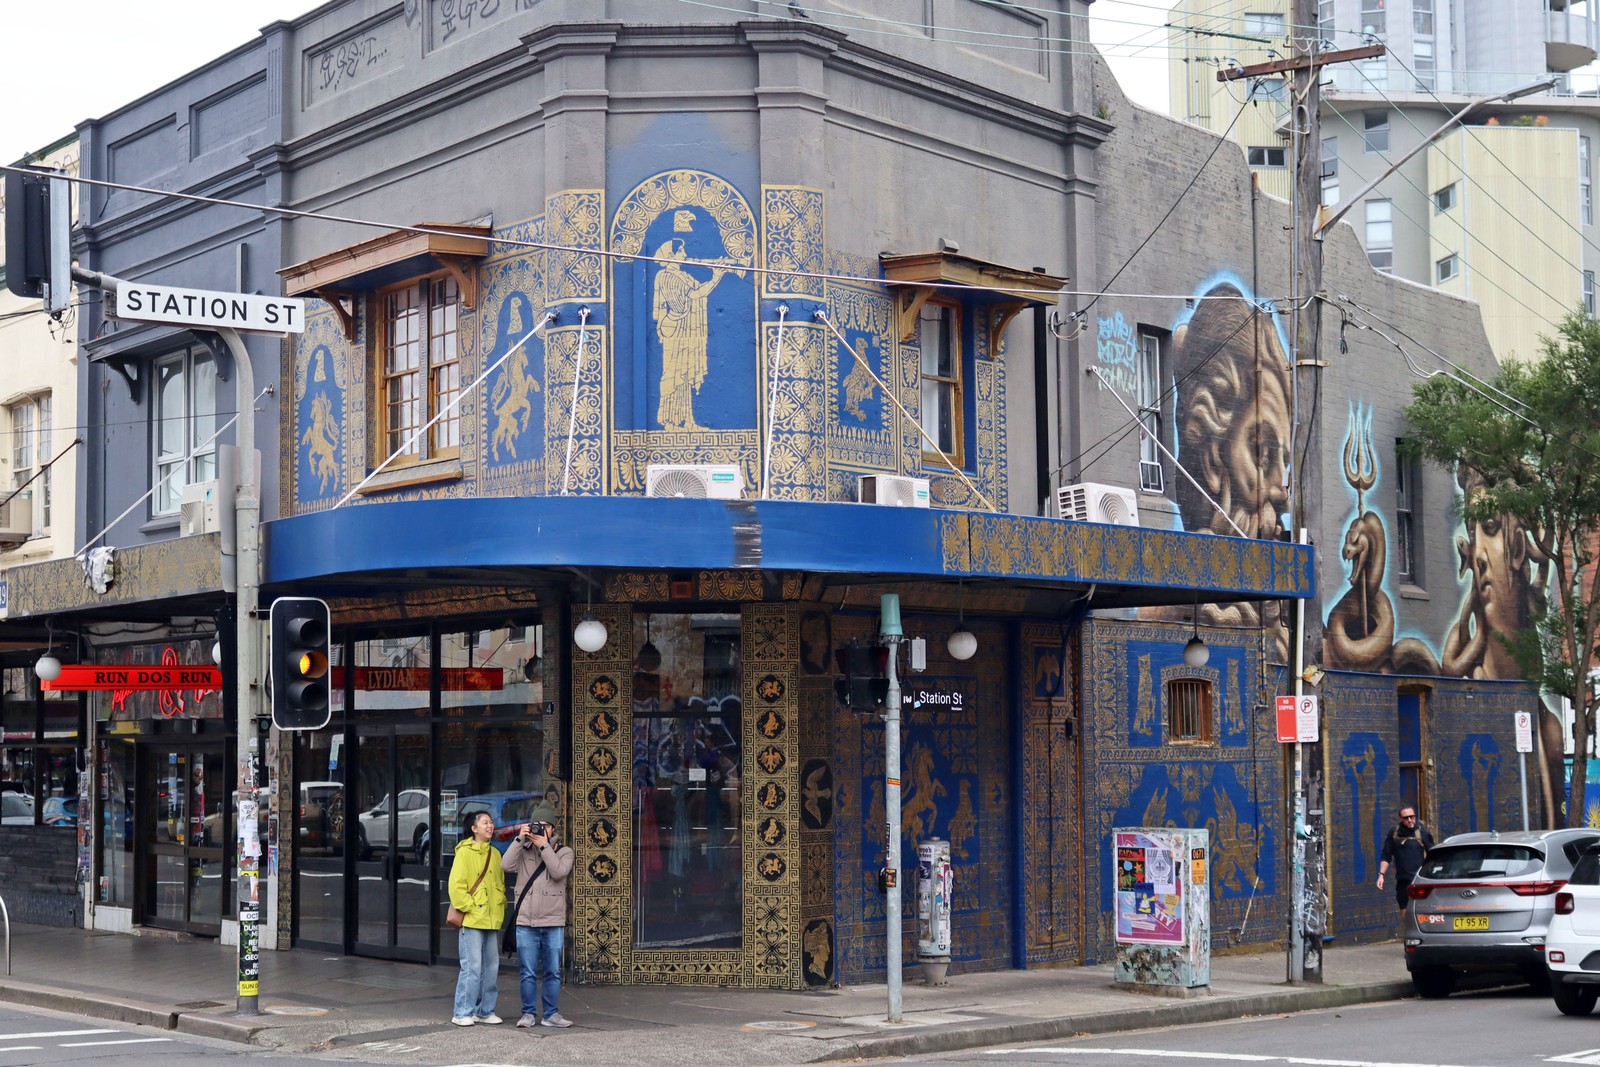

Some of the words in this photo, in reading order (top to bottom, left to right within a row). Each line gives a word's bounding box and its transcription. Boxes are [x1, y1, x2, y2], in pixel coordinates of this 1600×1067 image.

[126, 289, 247, 321] STATION
[264, 303, 297, 325] ST
[95, 671, 129, 684] RUN
[137, 671, 171, 684] DOS
[179, 671, 212, 684] RUN
[367, 668, 415, 689] LYDIAN
[919, 691, 951, 704] Station
[952, 692, 963, 705] St
[1417, 914, 1445, 924] goget
